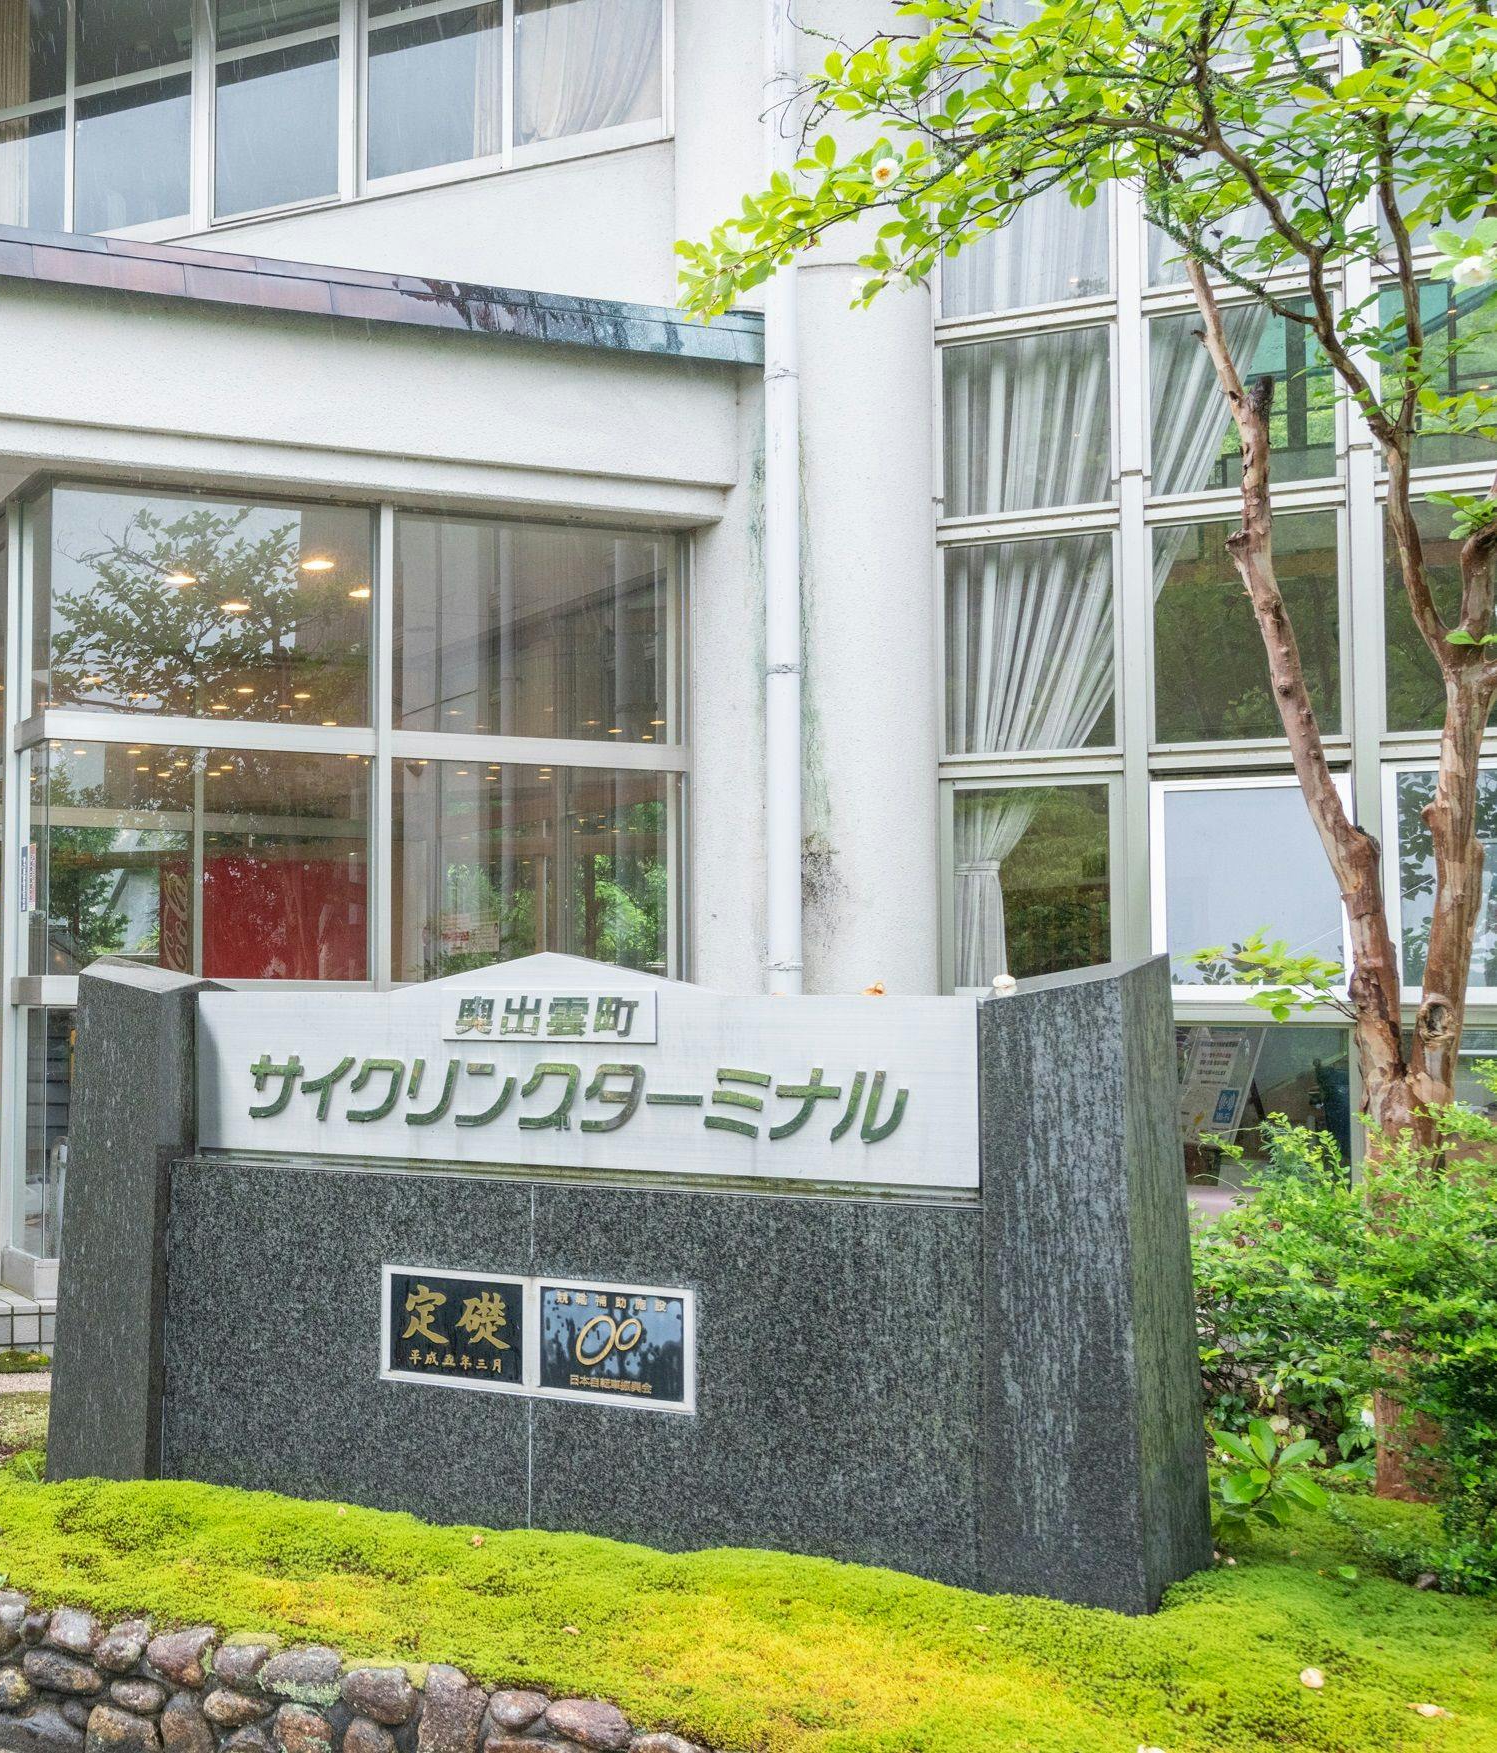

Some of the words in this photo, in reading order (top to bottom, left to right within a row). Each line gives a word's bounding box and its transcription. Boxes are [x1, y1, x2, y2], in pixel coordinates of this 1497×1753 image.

[454, 995, 640, 1038] 奥出雲町
[248, 1053, 911, 1145] サイクリングターミナル
[401, 1284, 512, 1350] 定礎
[408, 1348, 503, 1374] 平成五年三月
